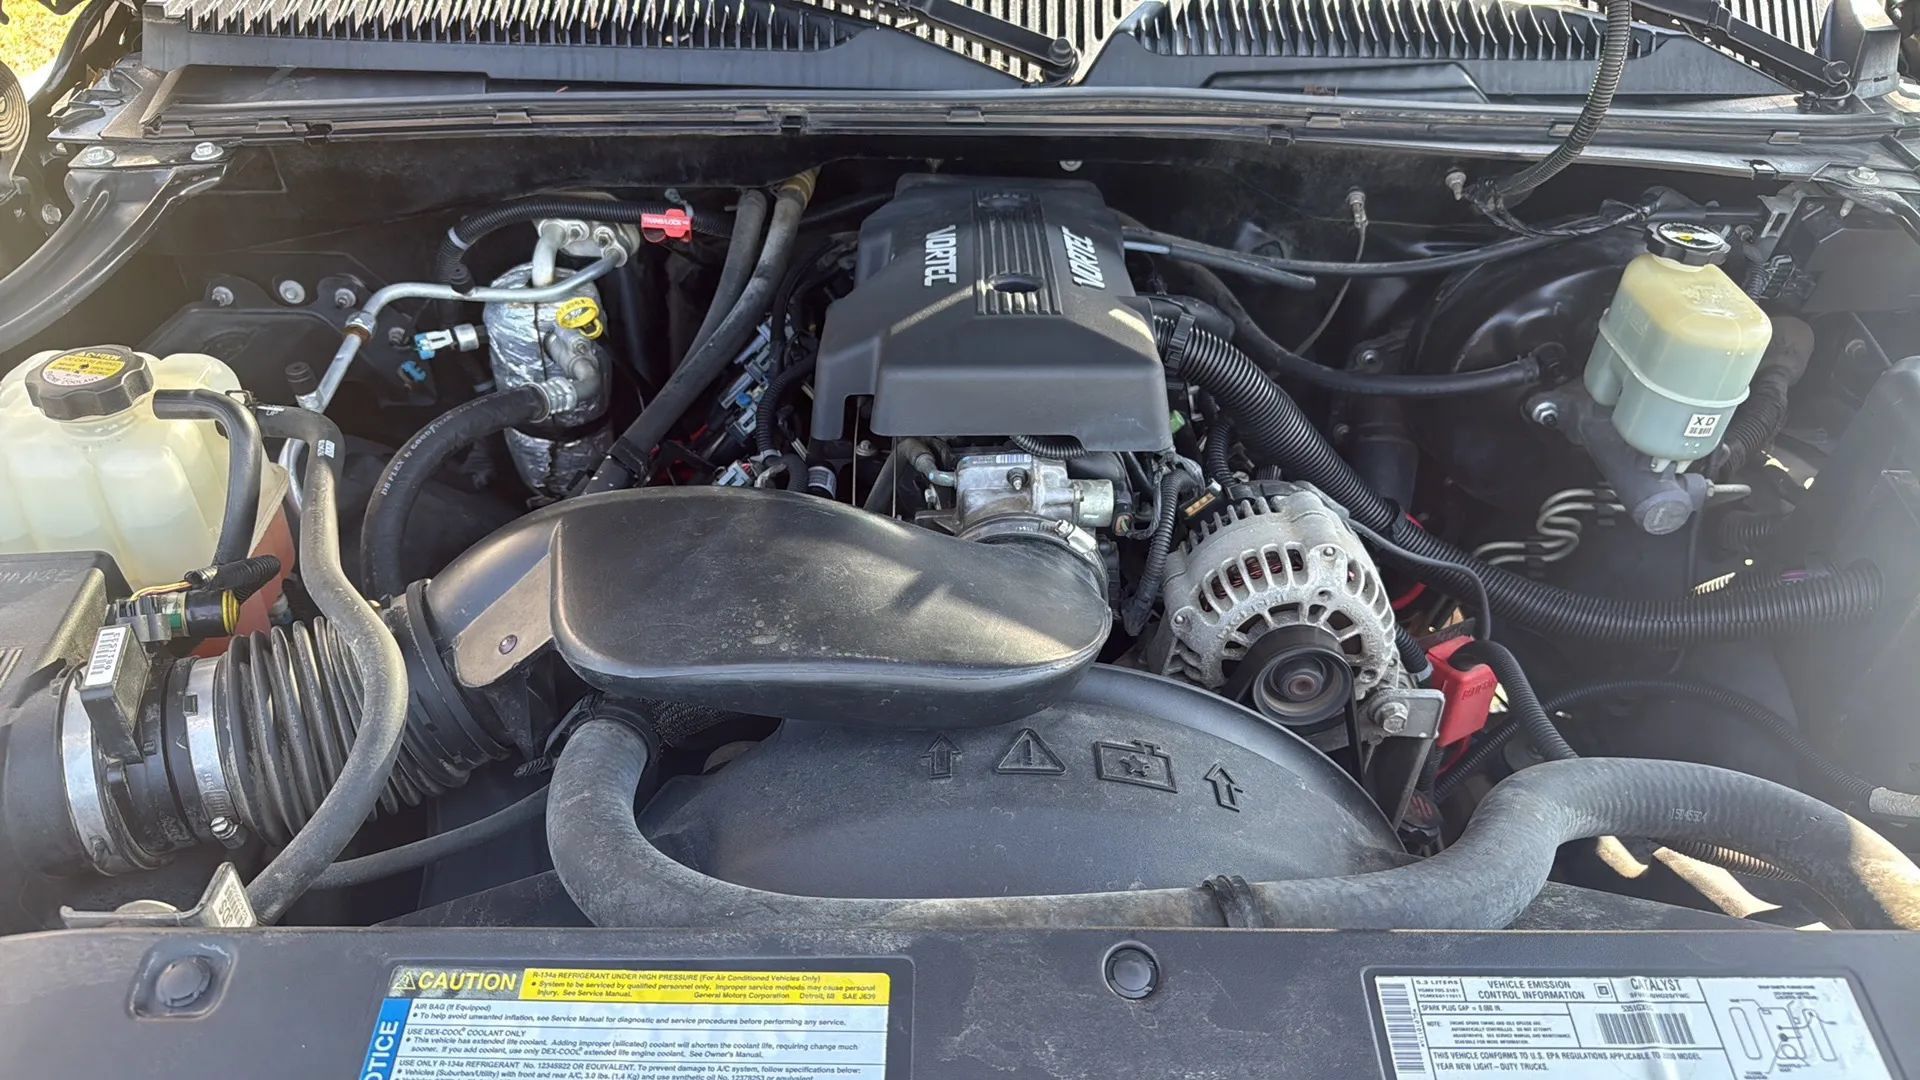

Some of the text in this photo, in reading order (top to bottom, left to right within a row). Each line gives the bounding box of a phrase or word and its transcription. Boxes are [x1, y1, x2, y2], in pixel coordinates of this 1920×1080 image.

[924, 225, 956, 286] VORTEC
[1062, 225, 1106, 289] VORTEC
[418, 971, 516, 991] CAUTION
[539, 980, 565, 989] System
[627, 982, 657, 990] qualified
[658, 982, 693, 990] personnel
[1487, 980, 1571, 989] VEHICLE EMISSION
[1630, 978, 1682, 991] CATALYST
[1478, 991, 1586, 1000] CONTROL INFORMATION
[504, 1014, 535, 1022] inflation,
[617, 1016, 654, 1024] diagnostic
[697, 1017, 738, 1026] procedures
[763, 1018, 802, 1027] performing
[362, 1021, 398, 1080] OTICE
[449, 1046, 462, 1054] you
[478, 1047, 507, 1055] coolant,
[524, 1048, 540, 1056] only
[630, 1050, 656, 1058] engine
[550, 1039, 577, 1048] Adding
[612, 1040, 648, 1049] (silicated)
[761, 1042, 774, 1051] life,
[776, 1043, 808, 1051] requiring
[810, 1043, 836, 1052] change
[648, 1064, 676, 1072] prevent
[677, 1064, 706, 1073] damage
[732, 1066, 760, 1074] system,
[785, 1066, 835, 1075] specifications
